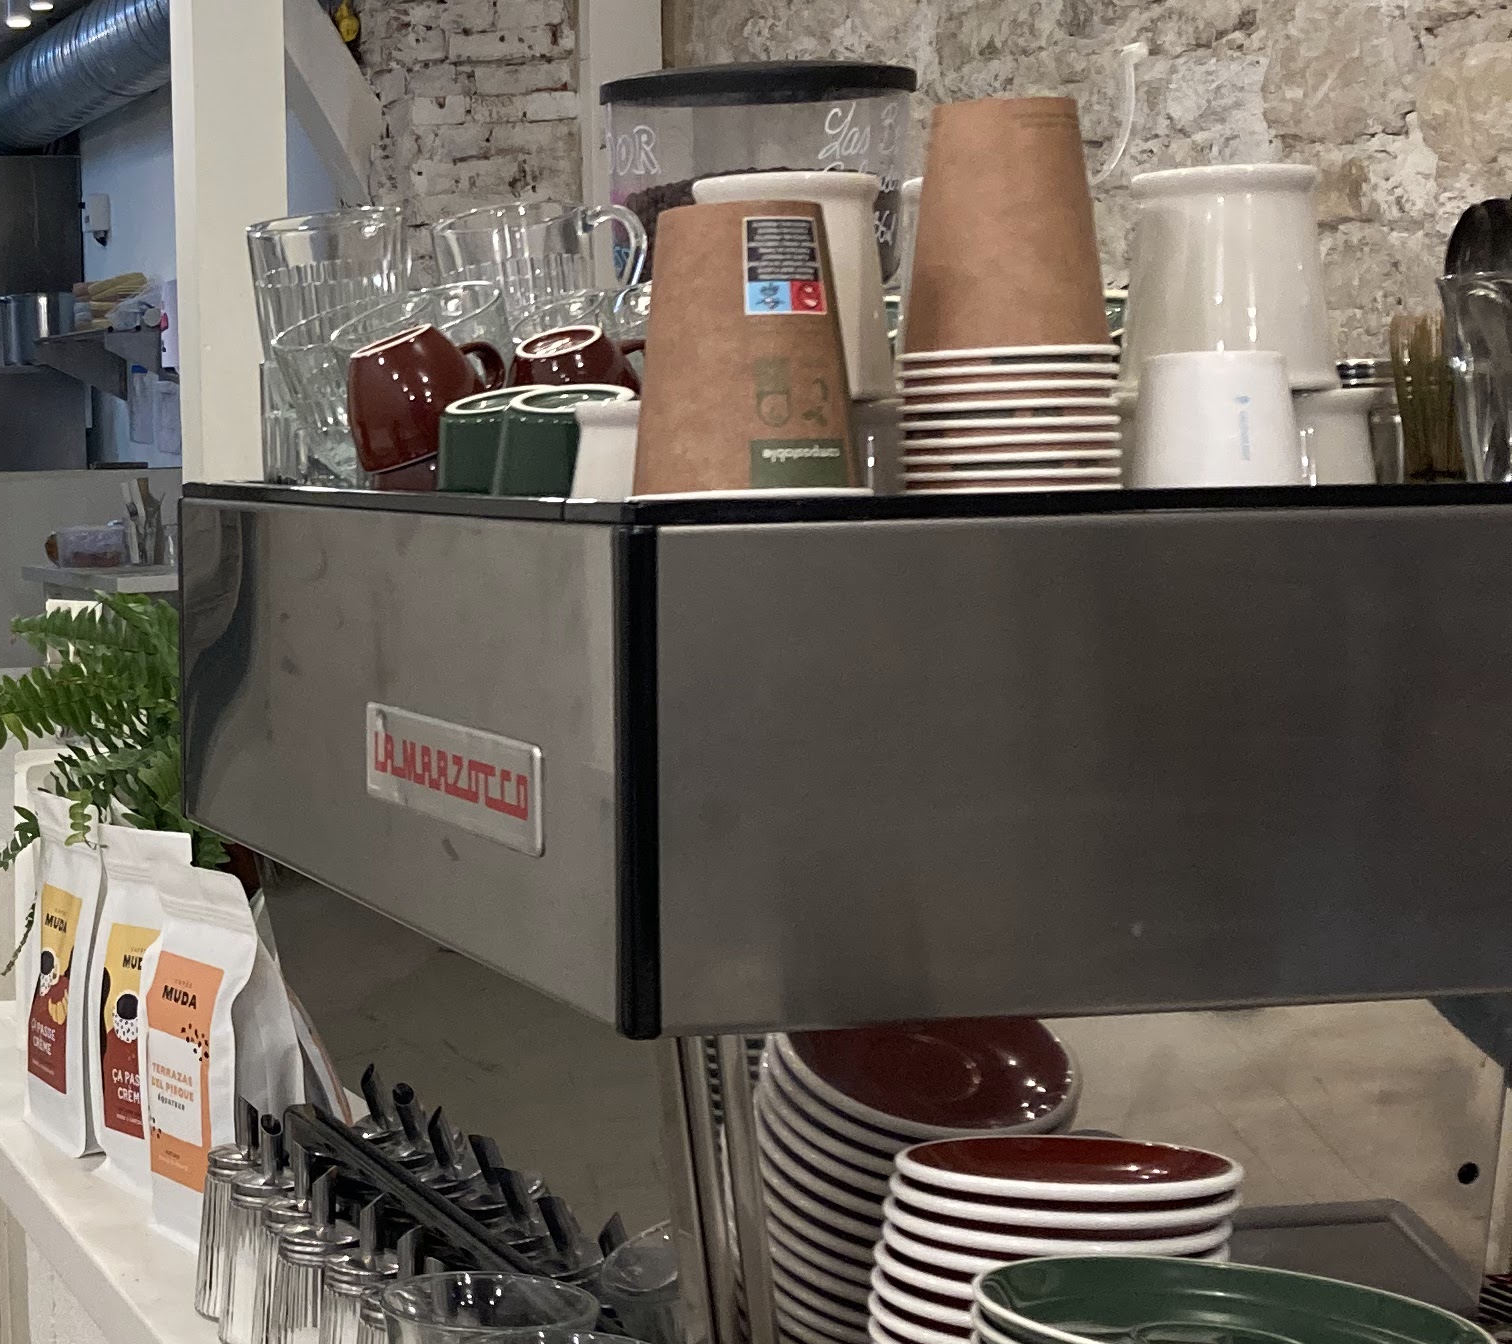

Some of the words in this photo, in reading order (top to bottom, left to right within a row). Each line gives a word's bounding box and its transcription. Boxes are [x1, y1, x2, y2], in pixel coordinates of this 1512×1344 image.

[44, 912, 68, 934] MUDA
[161, 984, 197, 1010] MUDA
[112, 1068, 123, 1084] ÇA
[124, 1071, 141, 1087] PAS
[151, 1062, 193, 1087] TERRAZAS
[117, 1085, 141, 1104] CRÈM
